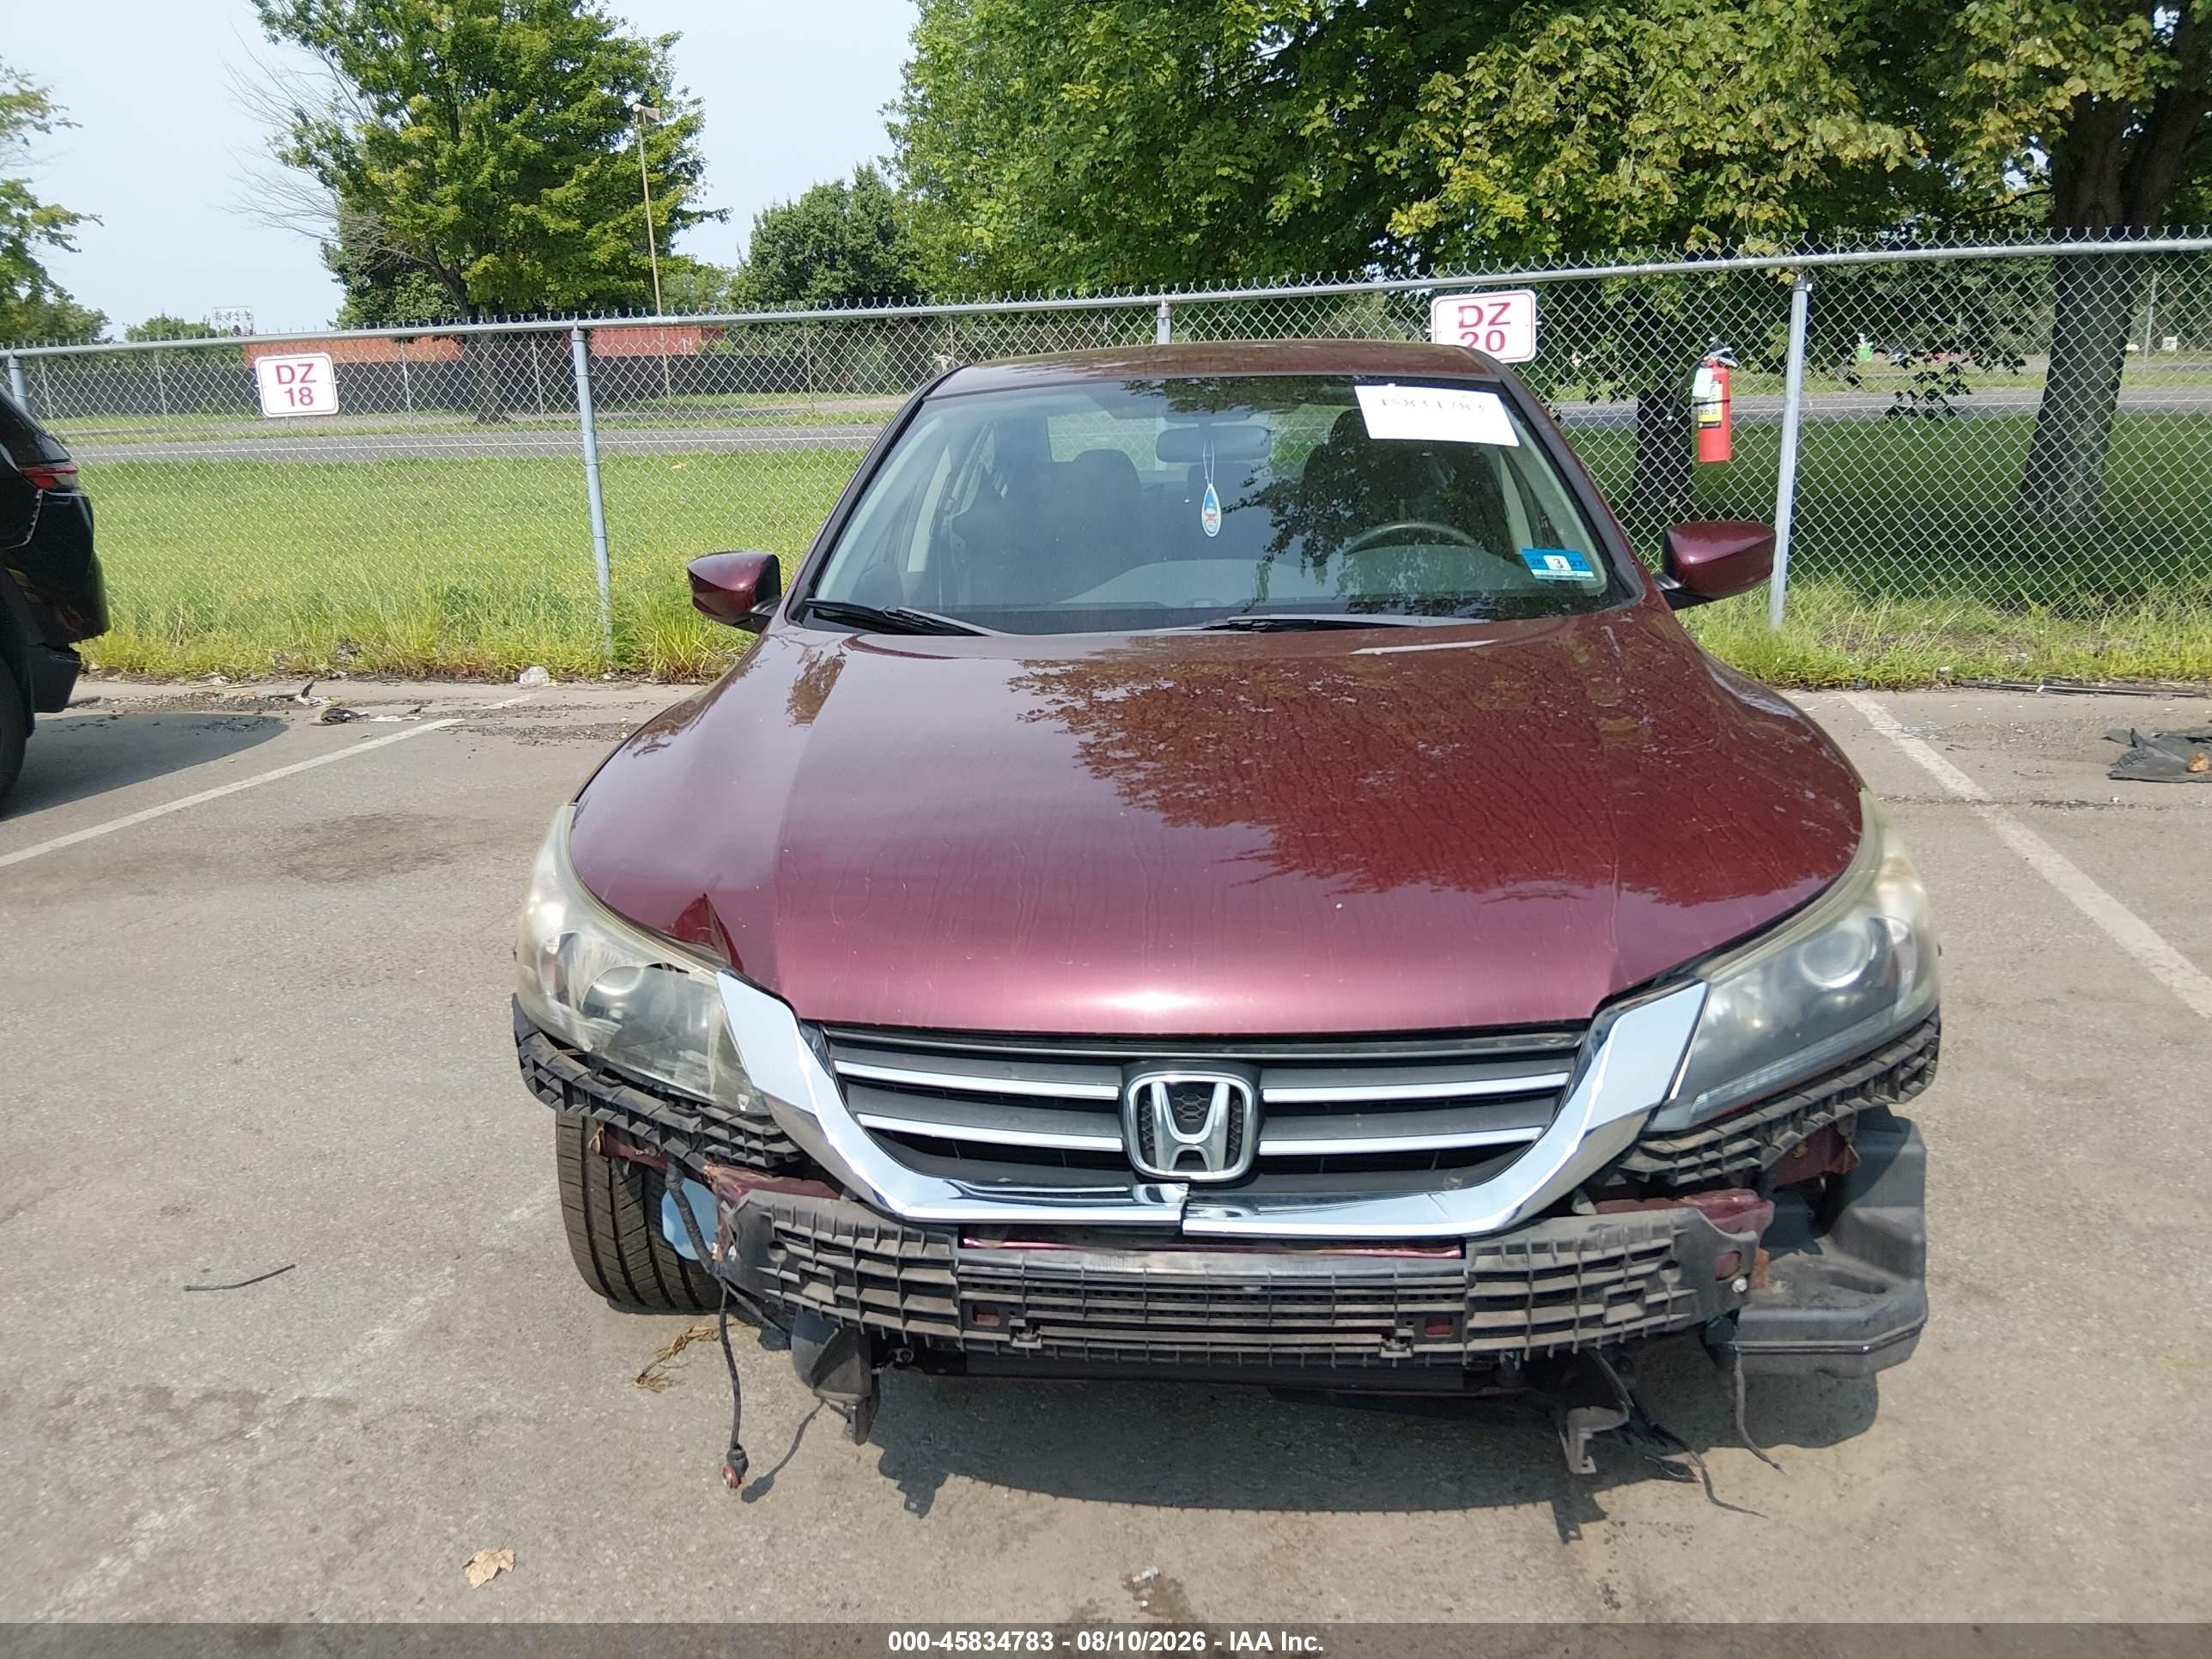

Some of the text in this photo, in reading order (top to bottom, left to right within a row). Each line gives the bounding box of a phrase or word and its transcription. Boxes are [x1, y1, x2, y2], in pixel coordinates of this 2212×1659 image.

[1457, 302, 1511, 329] DZ
[1460, 330, 1505, 352] 20
[276, 363, 317, 385] DZ
[284, 386, 313, 406] 18
[1553, 558, 1564, 568] 3
